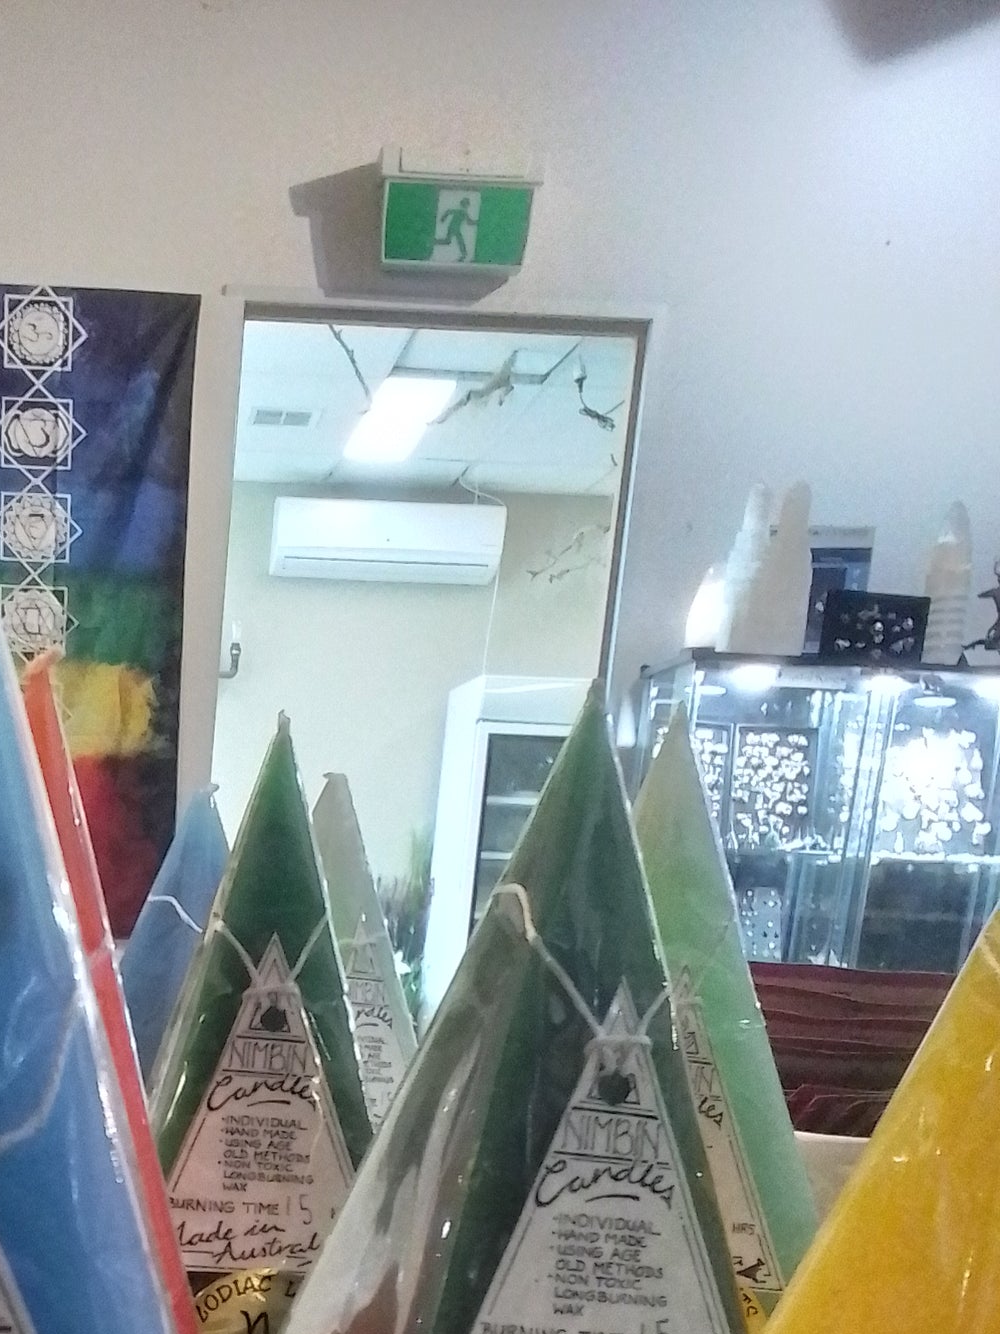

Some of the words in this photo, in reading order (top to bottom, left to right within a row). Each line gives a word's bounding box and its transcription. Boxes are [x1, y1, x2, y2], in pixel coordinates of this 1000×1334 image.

[228, 1039, 309, 1073] NIMBIN
[206, 1073, 317, 1112] Candles
[225, 1115, 308, 1130] INDIVIDUAL
[225, 1128, 259, 1138] HAND
[263, 1129, 297, 1140] MADE
[560, 1113, 665, 1160] NIMBIN
[225, 1139, 262, 1149] USING
[267, 1140, 292, 1150] AGE
[223, 1150, 248, 1159] OLD
[254, 1151, 311, 1163] METHODS
[223, 1160, 250, 1169] NON
[257, 1162, 294, 1172] TOXIC
[223, 1182, 247, 1192] WAX
[534, 1158, 675, 1210] Candles
[169, 1197, 235, 1214] BURNING
[243, 1201, 280, 1216] TIME
[243, 1219, 286, 1237] in
[557, 1212, 661, 1236] INDIVIDUAL
[213, 1232, 321, 1264] Austral
[557, 1230, 600, 1243] HAND
[604, 1232, 648, 1248] MADE
[557, 1244, 603, 1259] USING
[610, 1247, 642, 1263] AGE
[555, 1258, 586, 1273] OLD
[592, 1261, 664, 1279] METHODS
[554, 1273, 589, 1286] NON
[595, 1276, 644, 1290] TOXIC
[553, 1303, 585, 1316] WAX
